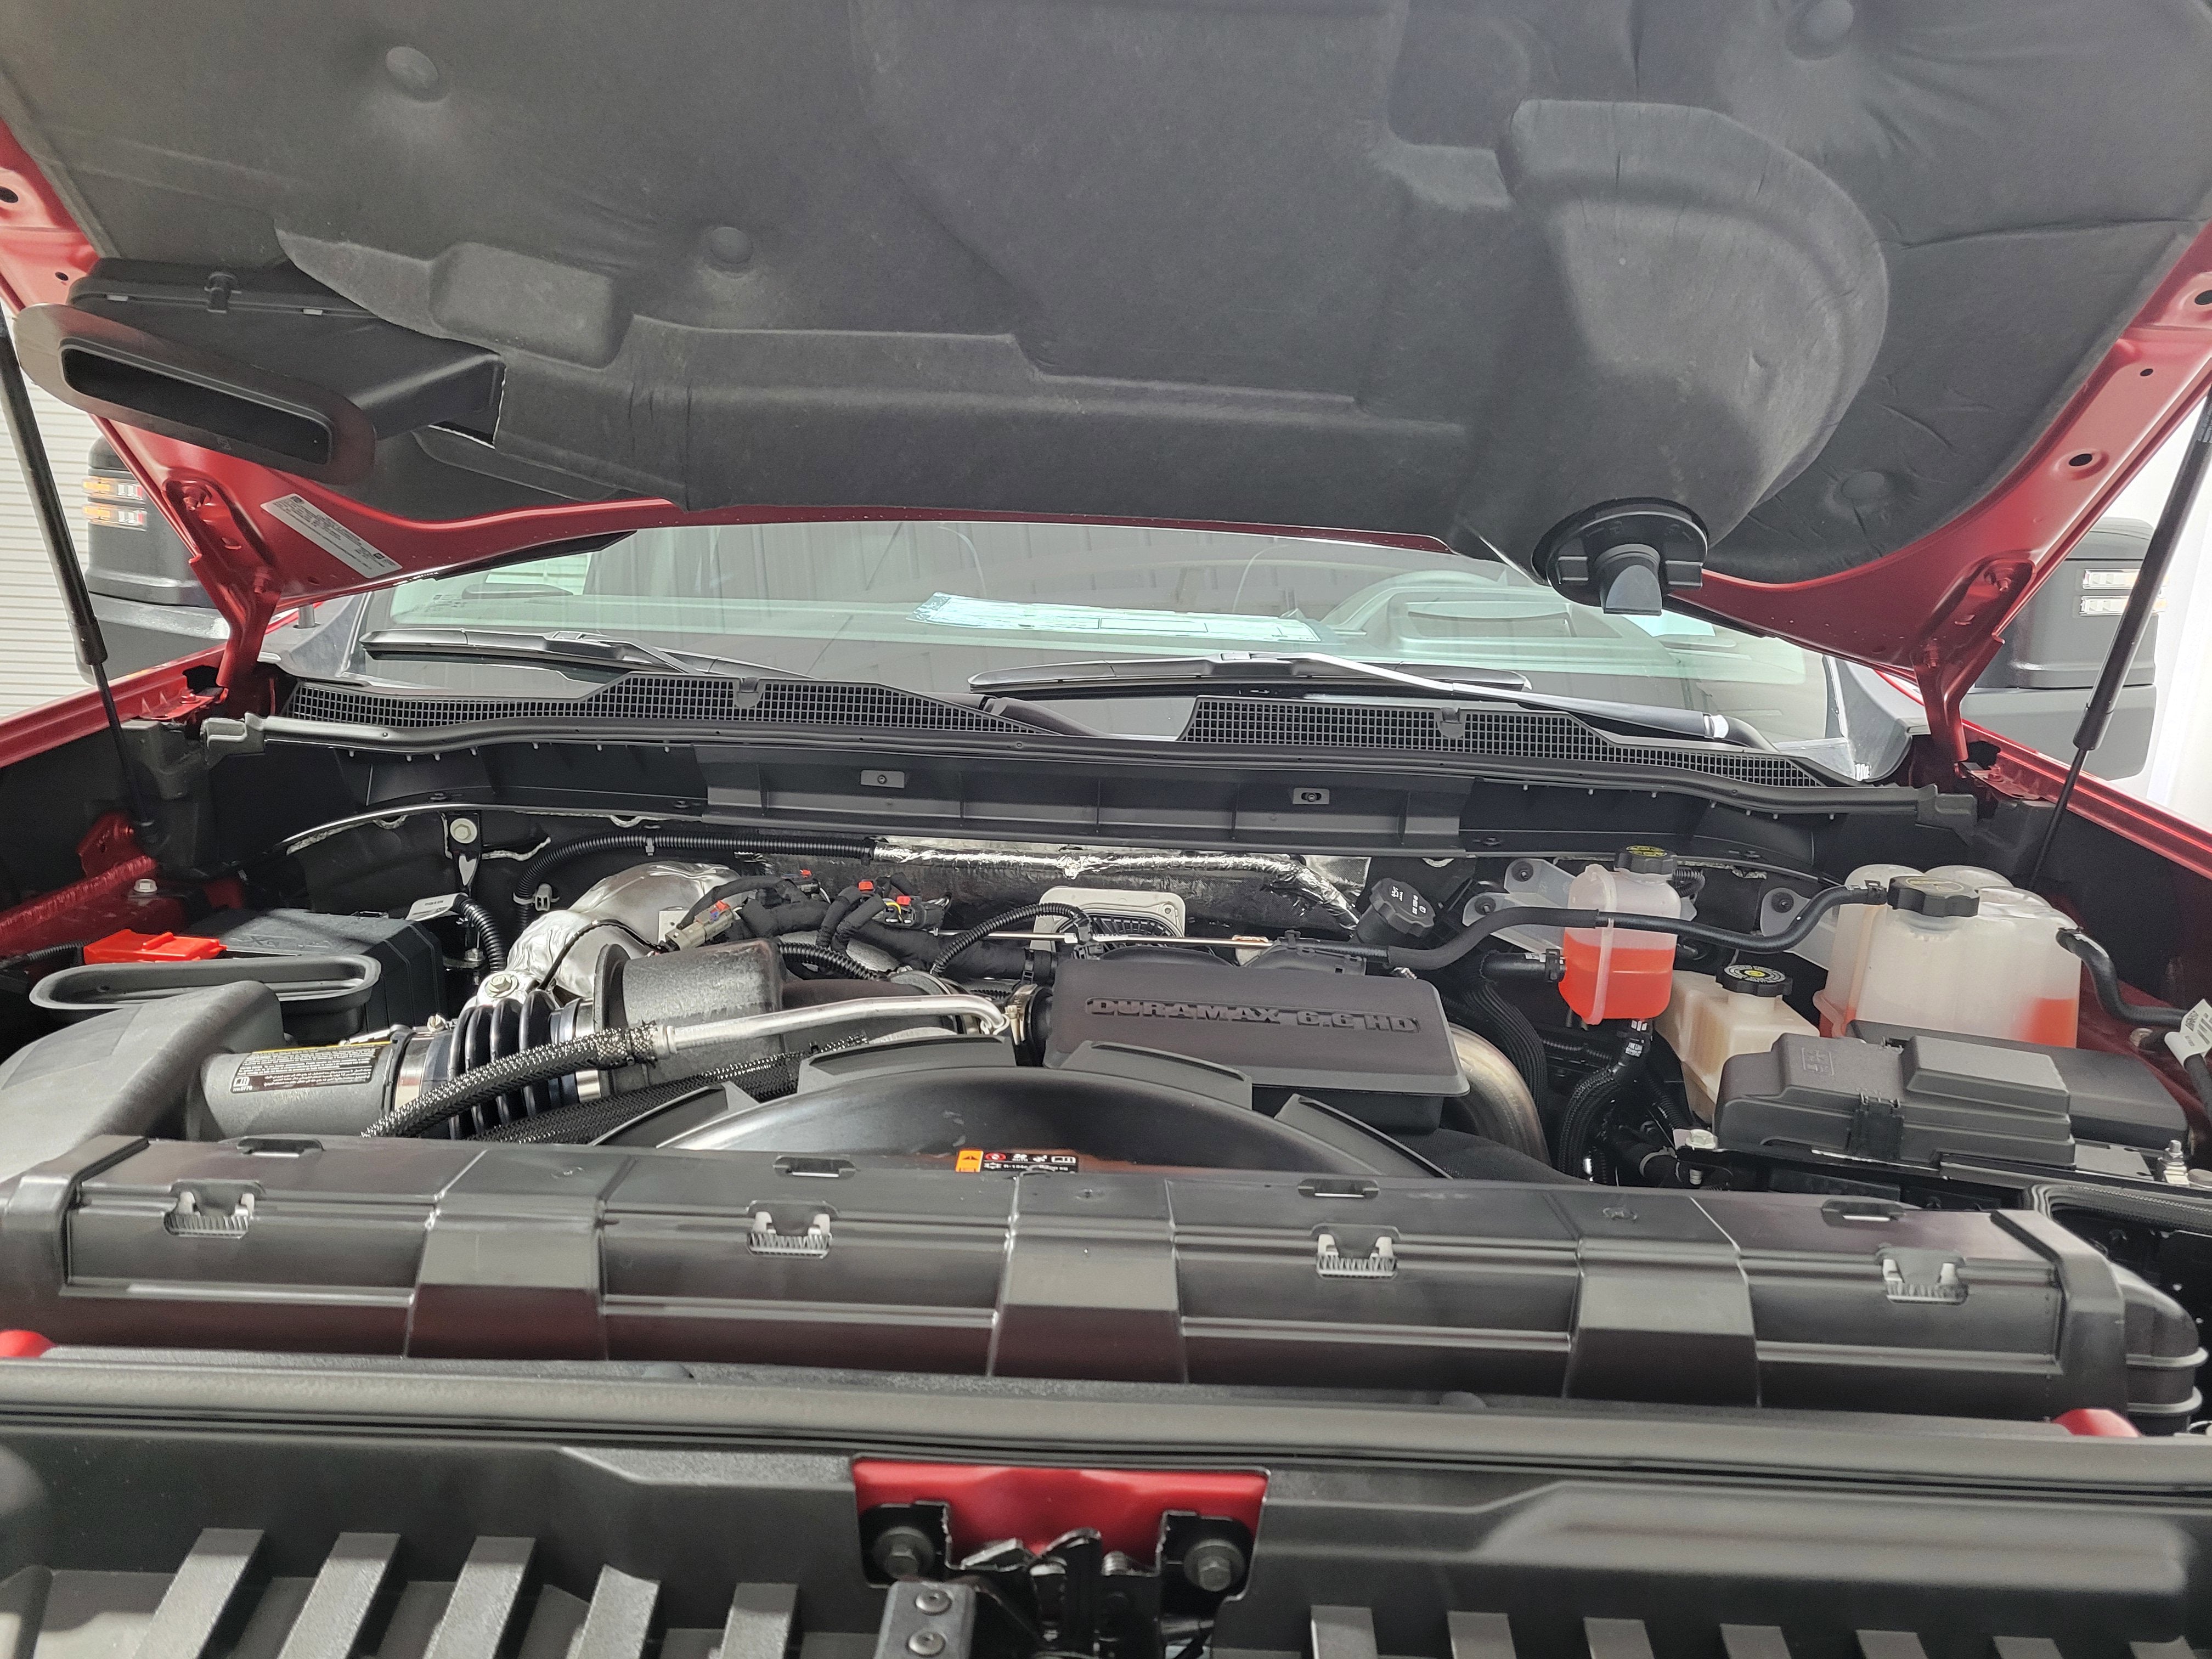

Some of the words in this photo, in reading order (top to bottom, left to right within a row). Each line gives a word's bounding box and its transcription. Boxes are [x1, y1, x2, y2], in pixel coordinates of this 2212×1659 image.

[1090, 1000, 1280, 1024] DURAMAX
[1296, 1011, 1355, 1028] 6.6
[1364, 1015, 1418, 1033] HD
